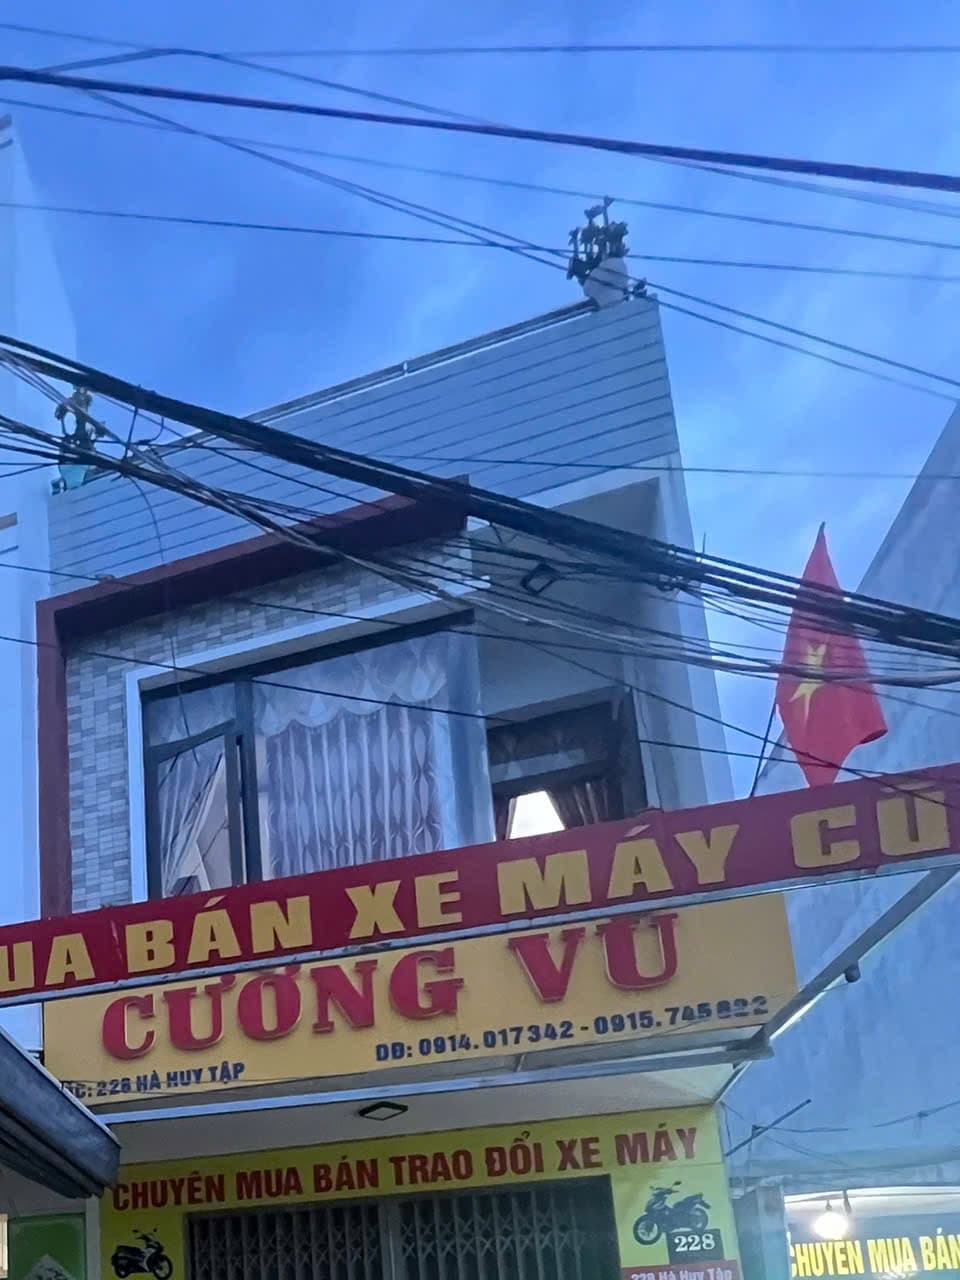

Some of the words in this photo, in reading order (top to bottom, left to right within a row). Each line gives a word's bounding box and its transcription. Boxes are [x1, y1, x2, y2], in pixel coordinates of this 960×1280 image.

[125, 896, 312, 973] BÁN
[345, 871, 463, 940] XE
[496, 824, 740, 917] MÁY
[789, 781, 950, 869] CŨ
[136, 1069, 162, 1092] HÀ
[166, 1067, 204, 1088] HUY
[208, 1060, 245, 1085] TẬP
[236, 1166, 304, 1201] MUA
[313, 1155, 379, 1194] BÁN
[389, 1149, 473, 1187] TRAO
[485, 1130, 545, 1177] ĐỔI
[556, 1137, 603, 1172] XE
[615, 1122, 697, 1166] MÁY
[673, 1233, 716, 1252] 228
[867, 1237, 918, 1273] MUA
